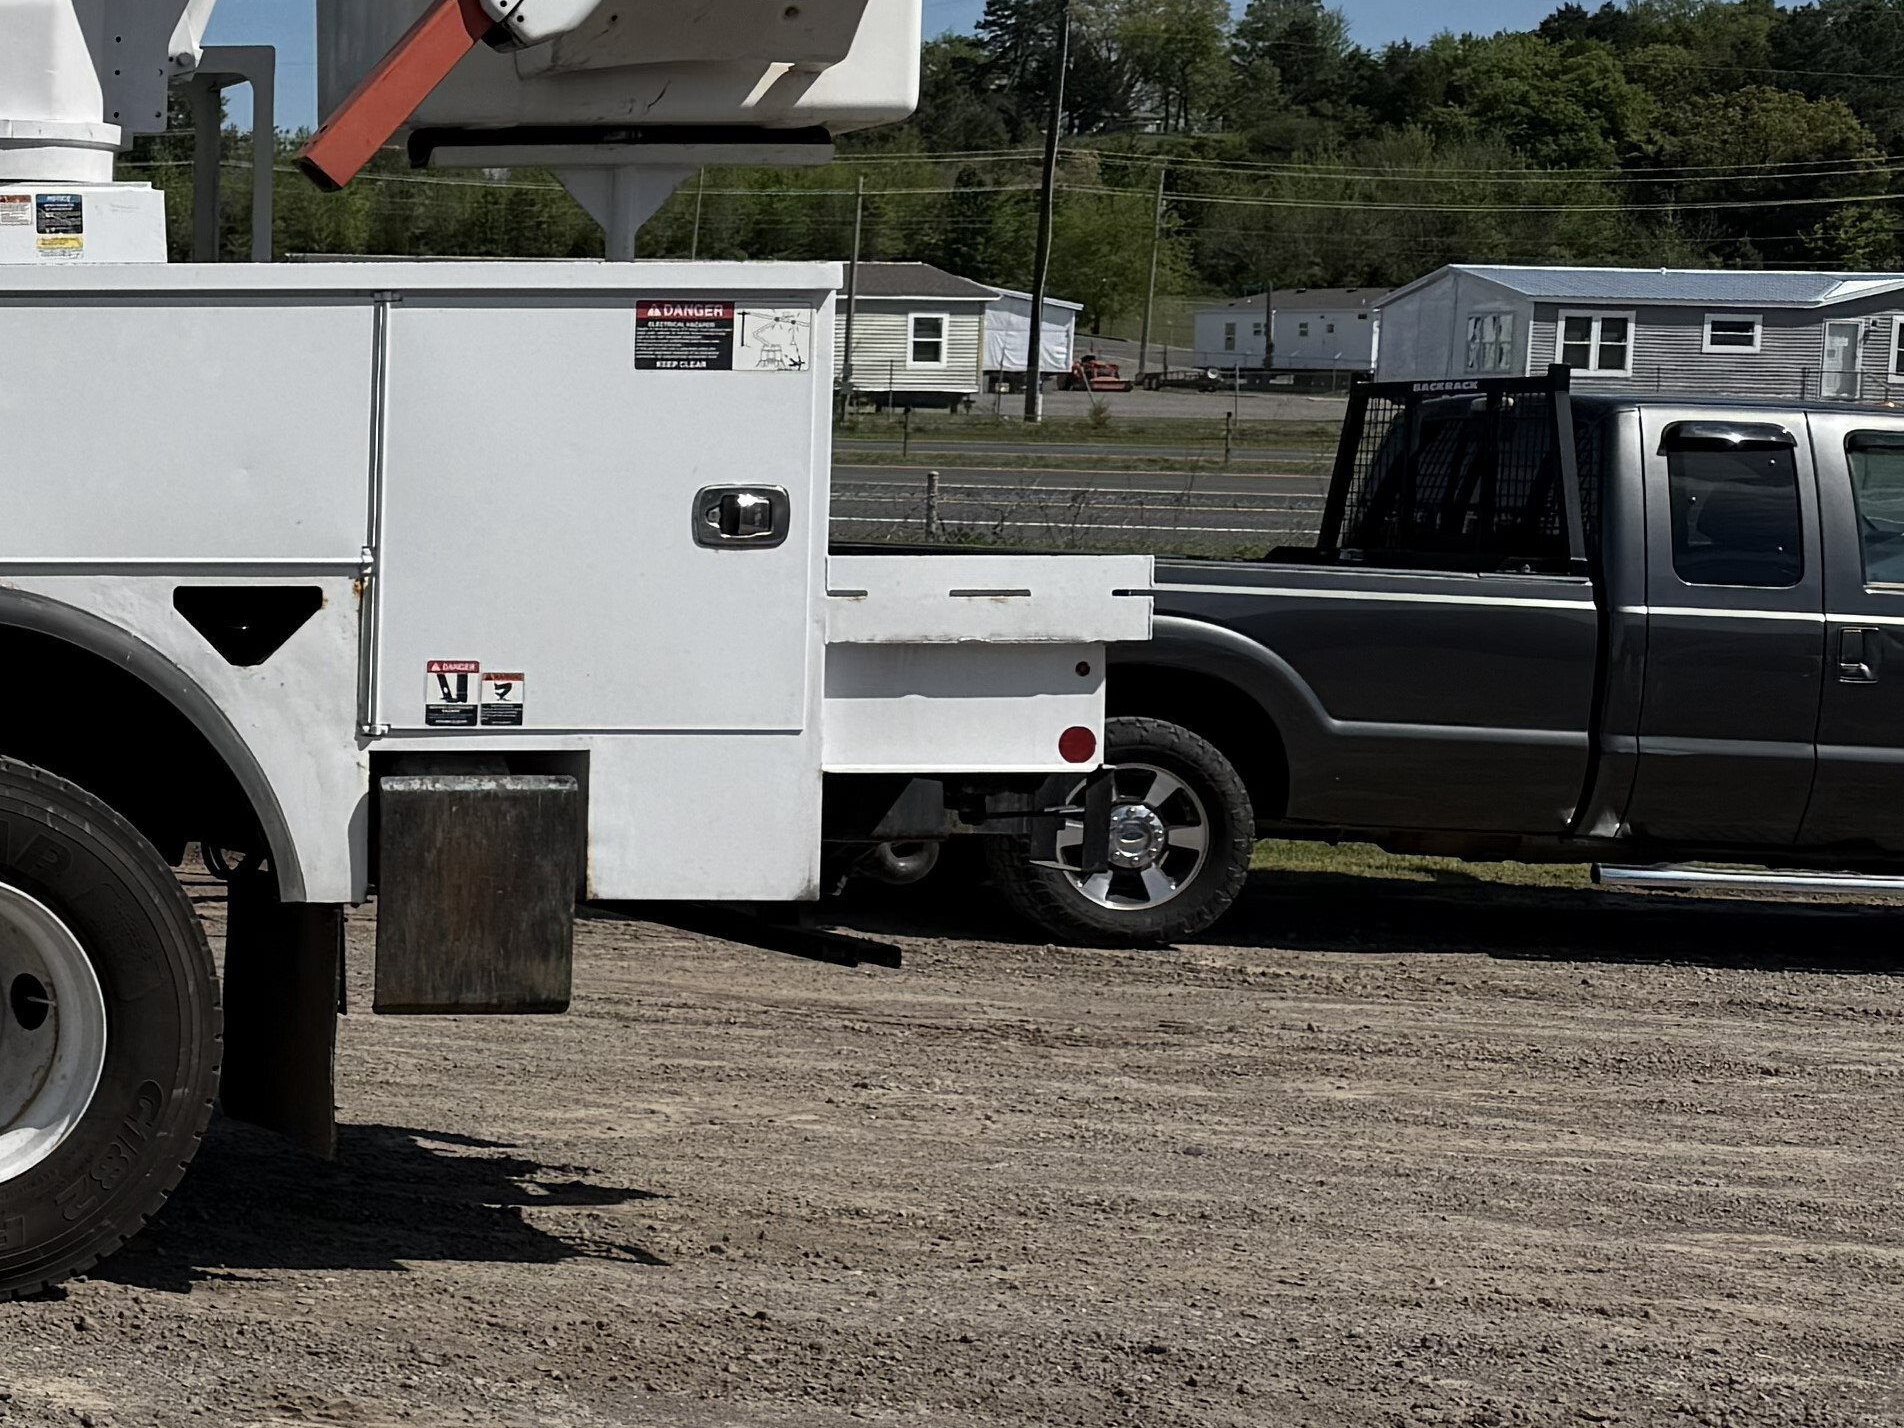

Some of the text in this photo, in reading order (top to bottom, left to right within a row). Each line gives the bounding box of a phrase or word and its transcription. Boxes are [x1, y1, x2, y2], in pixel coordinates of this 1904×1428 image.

[663, 304, 724, 317] DANGER
[679, 360, 707, 368] CLEAR
[1413, 381, 1479, 392] BACKRACK
